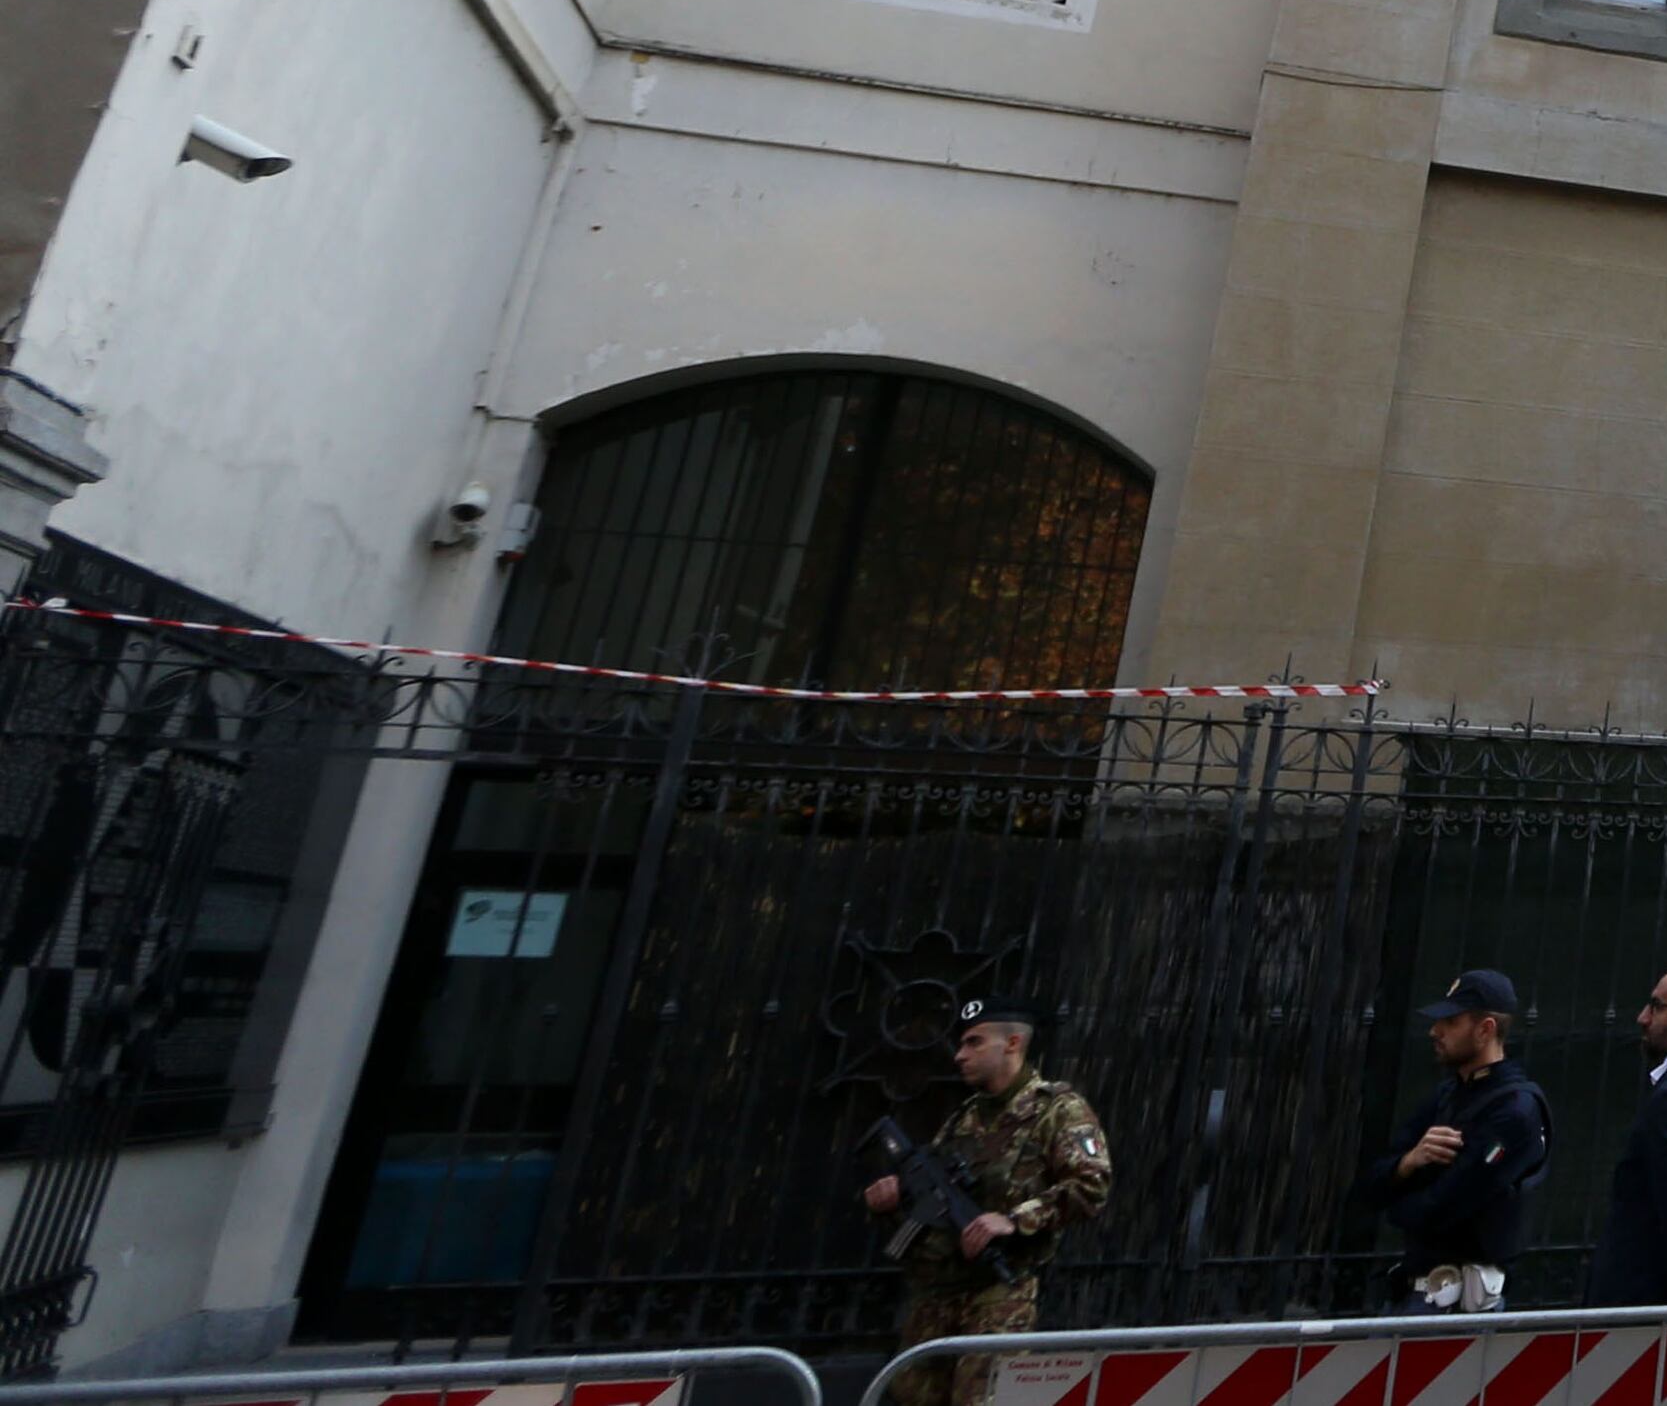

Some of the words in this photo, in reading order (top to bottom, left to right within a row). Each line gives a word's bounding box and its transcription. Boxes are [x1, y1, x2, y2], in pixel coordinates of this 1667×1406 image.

[1008, 1360, 1041, 1370] Comune
[1043, 1360, 1051, 1368] di
[1055, 1358, 1083, 1368] Milano
